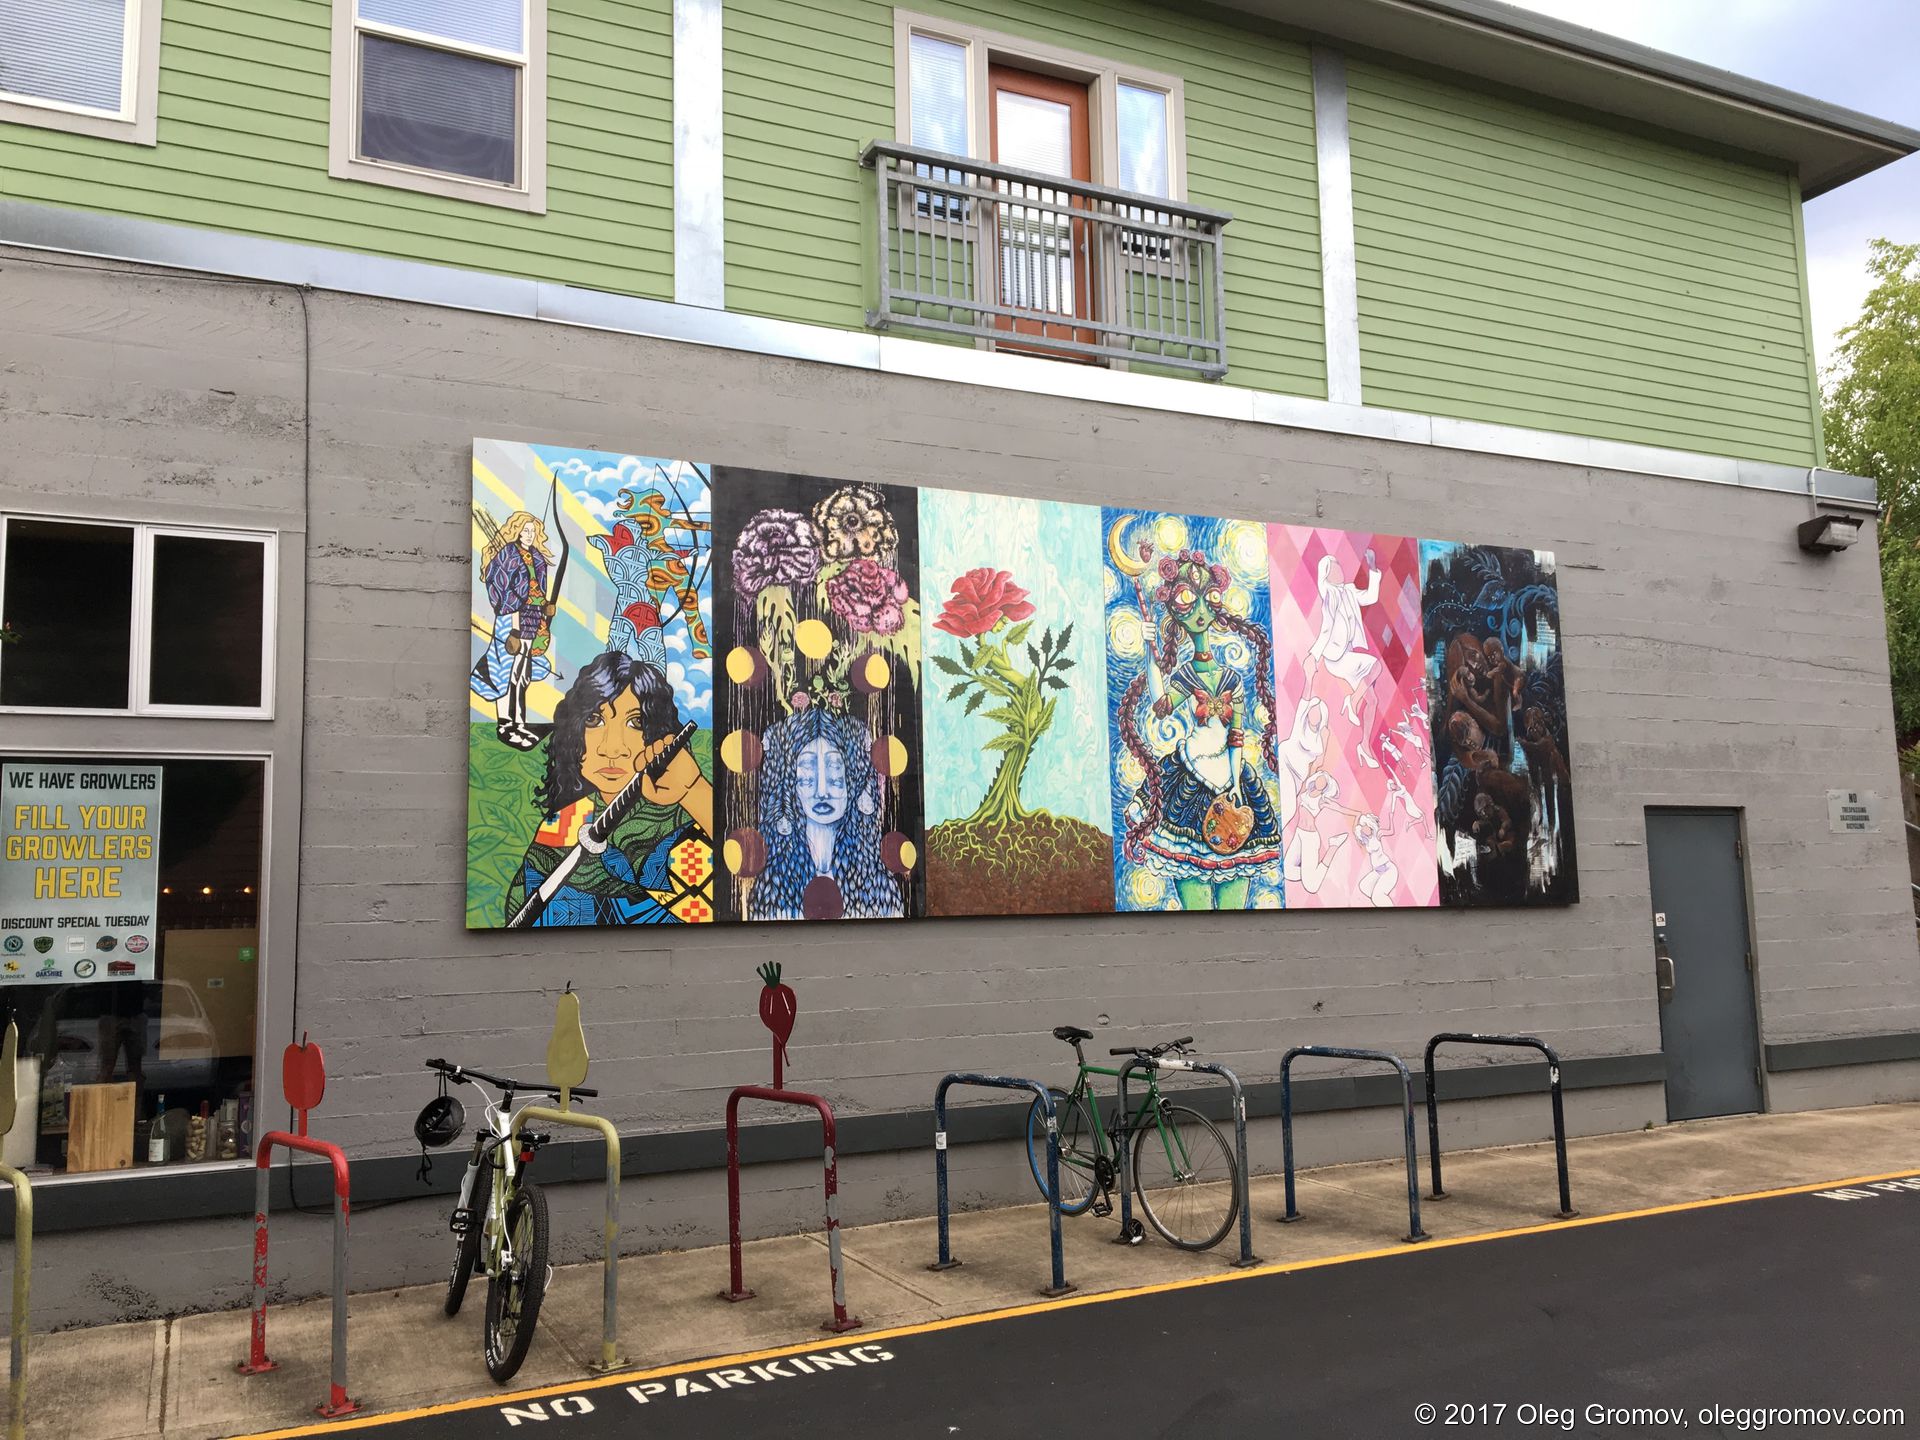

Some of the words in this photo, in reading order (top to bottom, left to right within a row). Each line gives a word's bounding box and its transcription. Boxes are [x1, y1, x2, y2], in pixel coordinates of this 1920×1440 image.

[9, 771, 34, 788] WE
[39, 772, 75, 788] HAVE
[80, 773, 156, 790] GROWLERS
[1848, 793, 1857, 803] NO
[14, 805, 70, 830] FILL
[79, 805, 147, 830] YOUR
[6, 835, 152, 860] GROWLERS
[34, 866, 123, 899] HERE
[1, 917, 54, 930] DISCOUNT
[57, 916, 101, 929] SPECIAL
[105, 915, 150, 927] TUESDAY
[1811, 1189, 1880, 1200] NO
[500, 1396, 595, 1427] NO
[626, 1345, 895, 1404] PARKING
